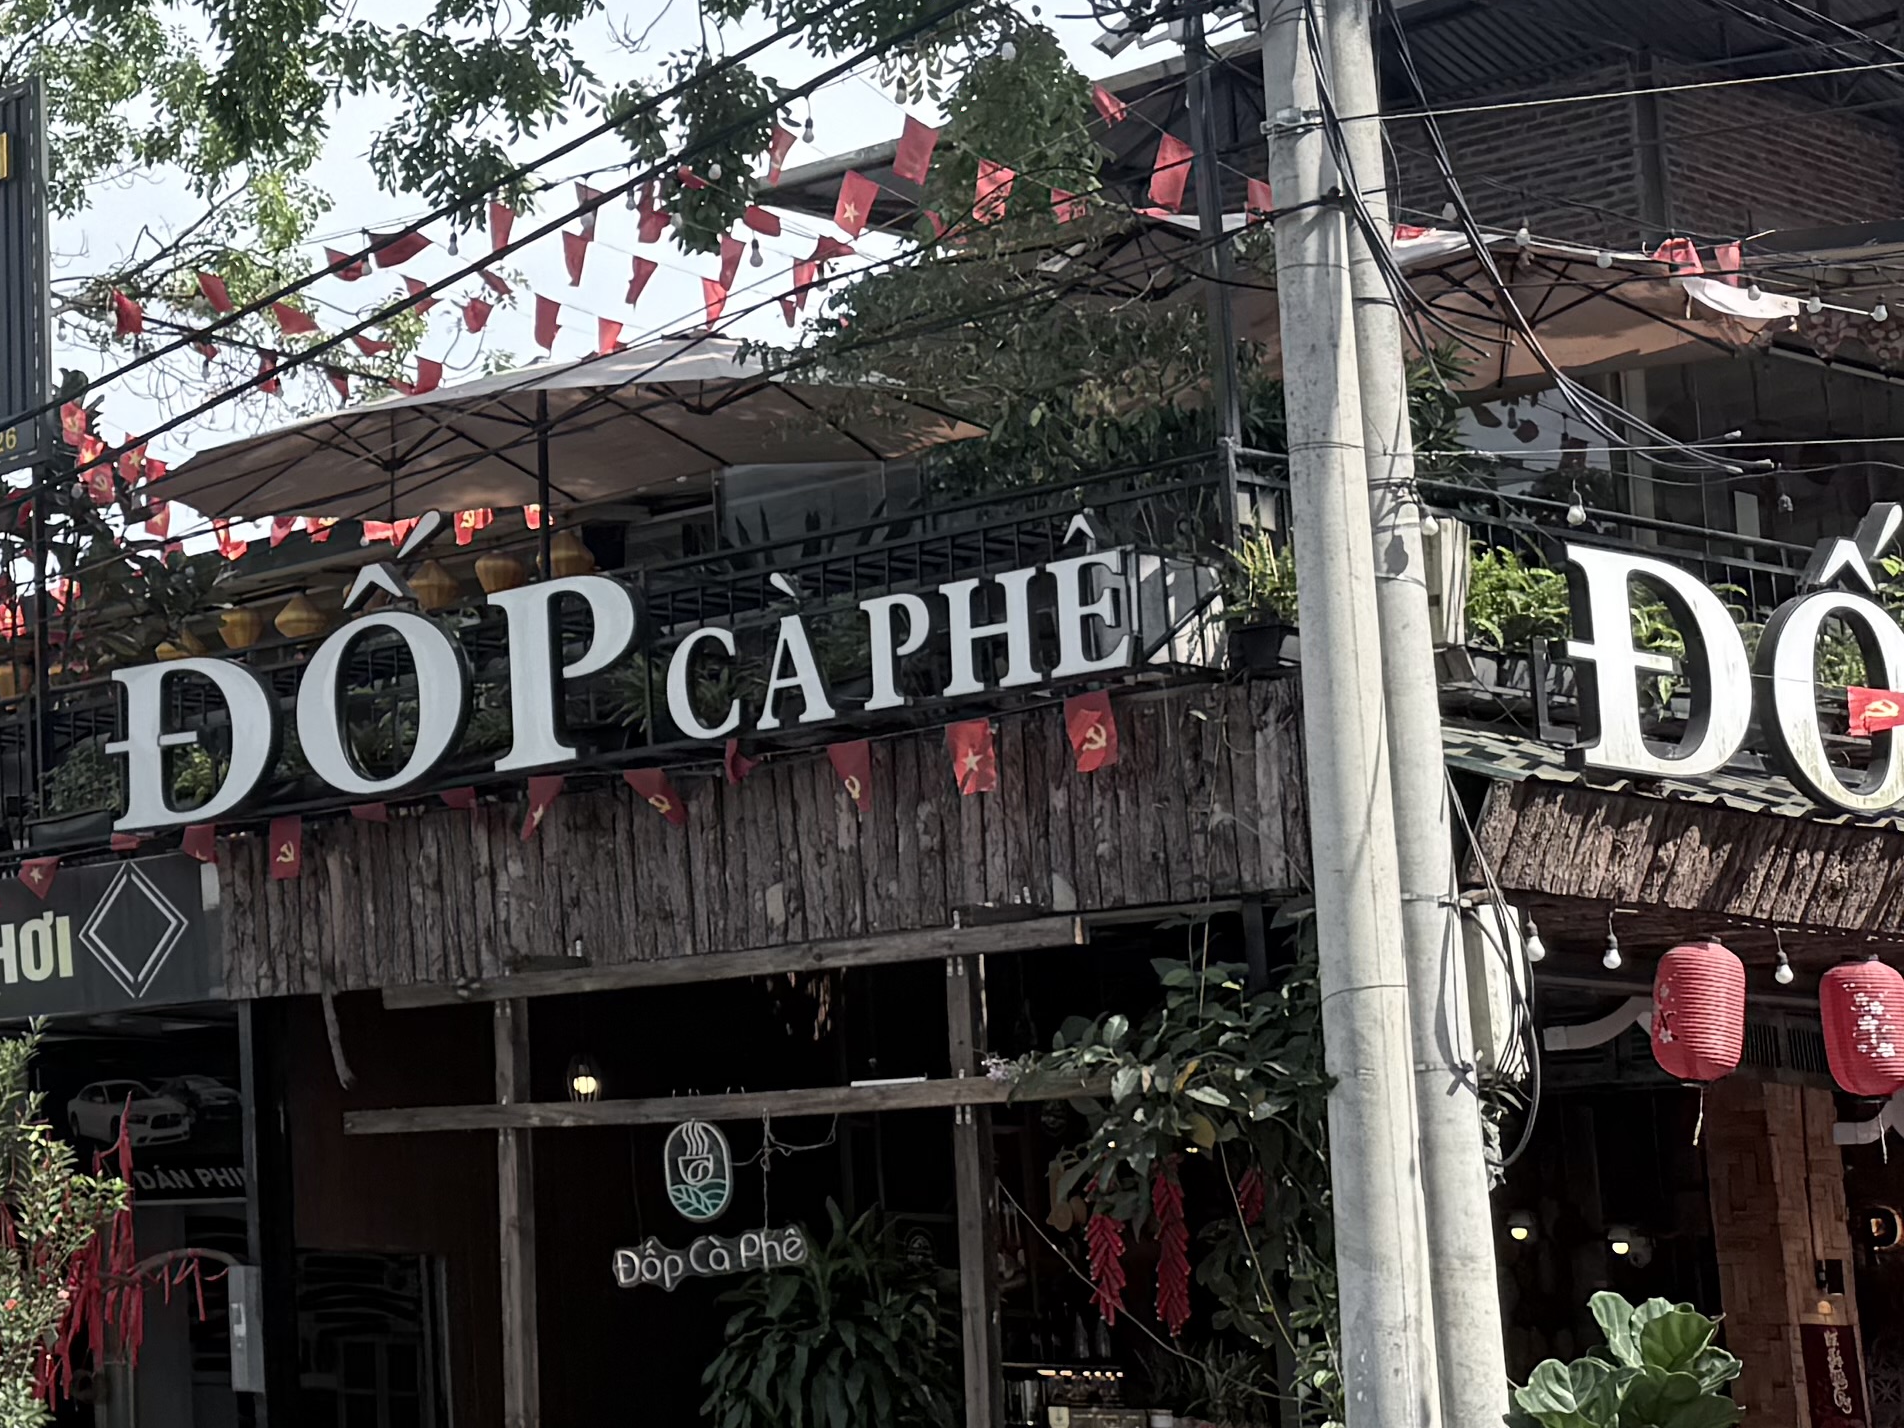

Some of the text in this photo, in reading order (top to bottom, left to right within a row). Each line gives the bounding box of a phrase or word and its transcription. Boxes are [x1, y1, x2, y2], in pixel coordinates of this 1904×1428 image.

[105, 509, 1134, 832] ĐỐP CÀ PHÊ
[617, 1228, 805, 1289] Đốp Cà Phê
